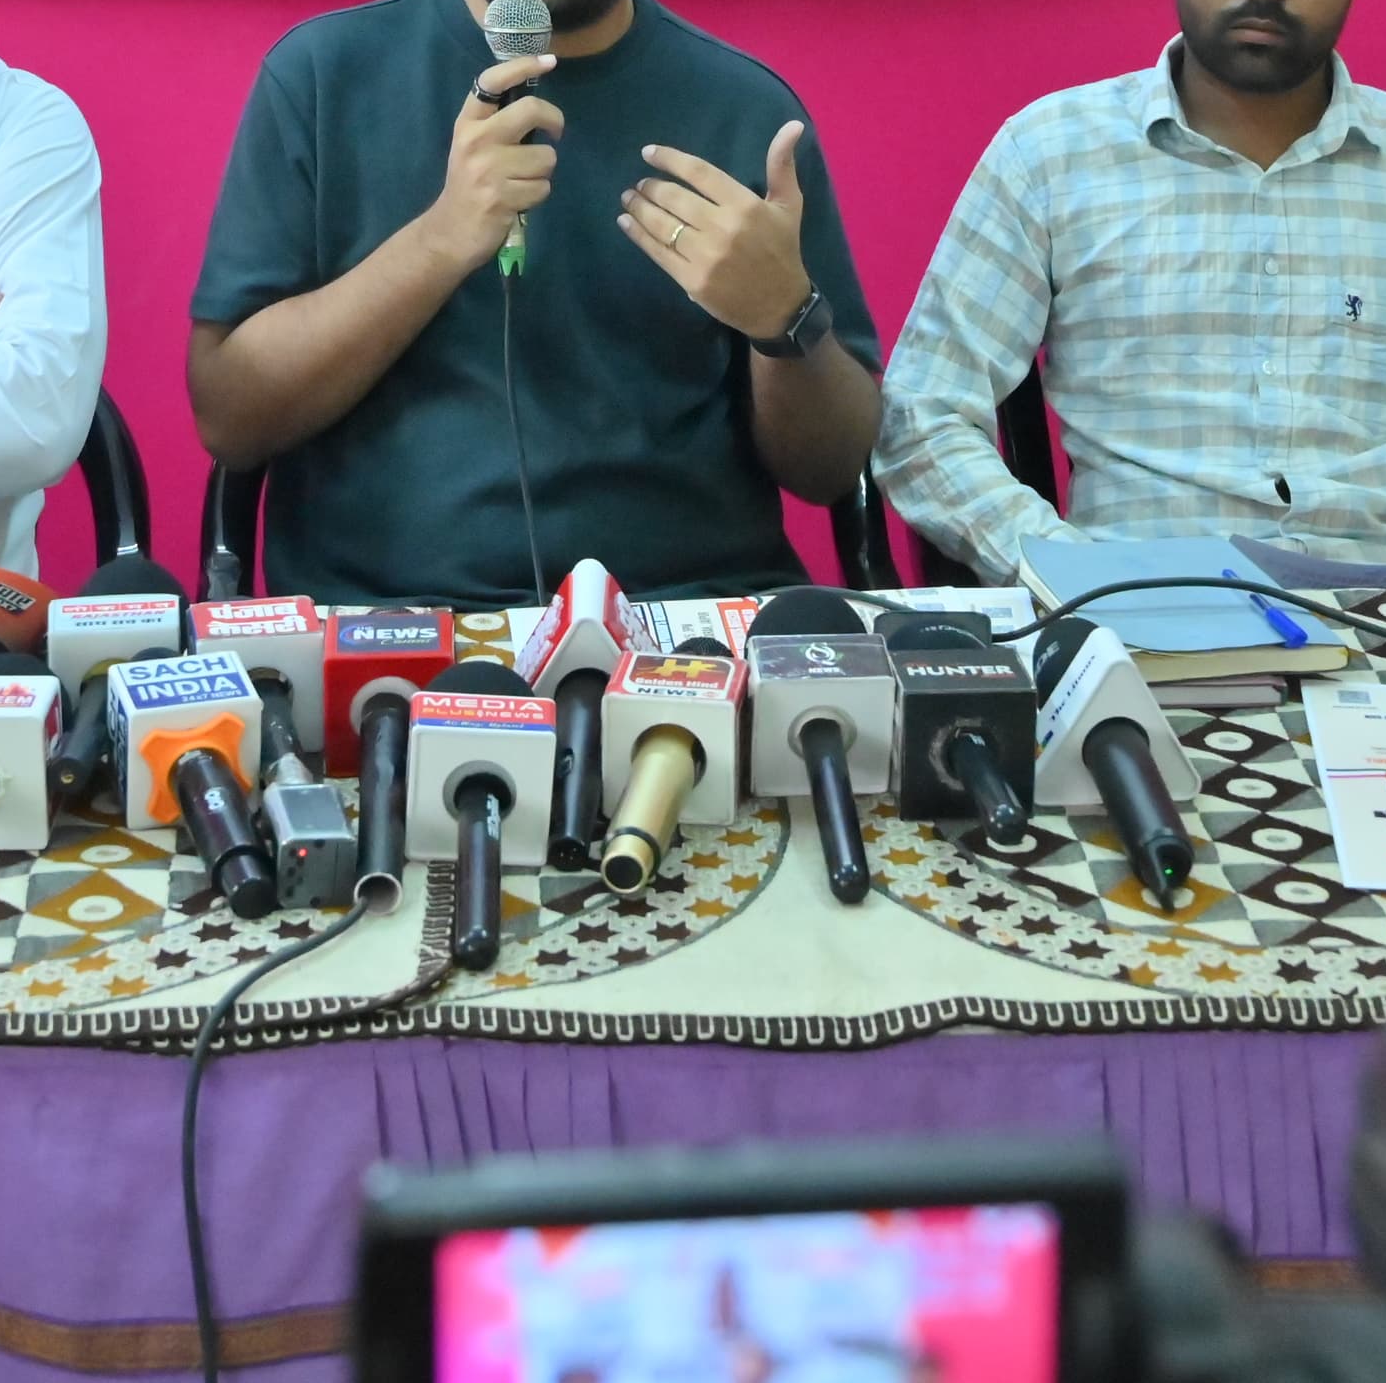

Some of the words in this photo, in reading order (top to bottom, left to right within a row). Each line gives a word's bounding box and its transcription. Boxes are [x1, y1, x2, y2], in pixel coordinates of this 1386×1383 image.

[208, 602, 298, 619] पंजाब
[207, 616, 307, 635] केसरी
[353, 627, 438, 640] NEWS
[129, 656, 229, 680] SACH
[906, 665, 1015, 676] HUNTER
[136, 676, 238, 701] INDIA
[635, 677, 684, 687] Golden
[638, 687, 697, 697] NEWS
[422, 696, 544, 712] MEDIA
[421, 707, 475, 716] PLUS
[485, 711, 545, 720] NEWS
